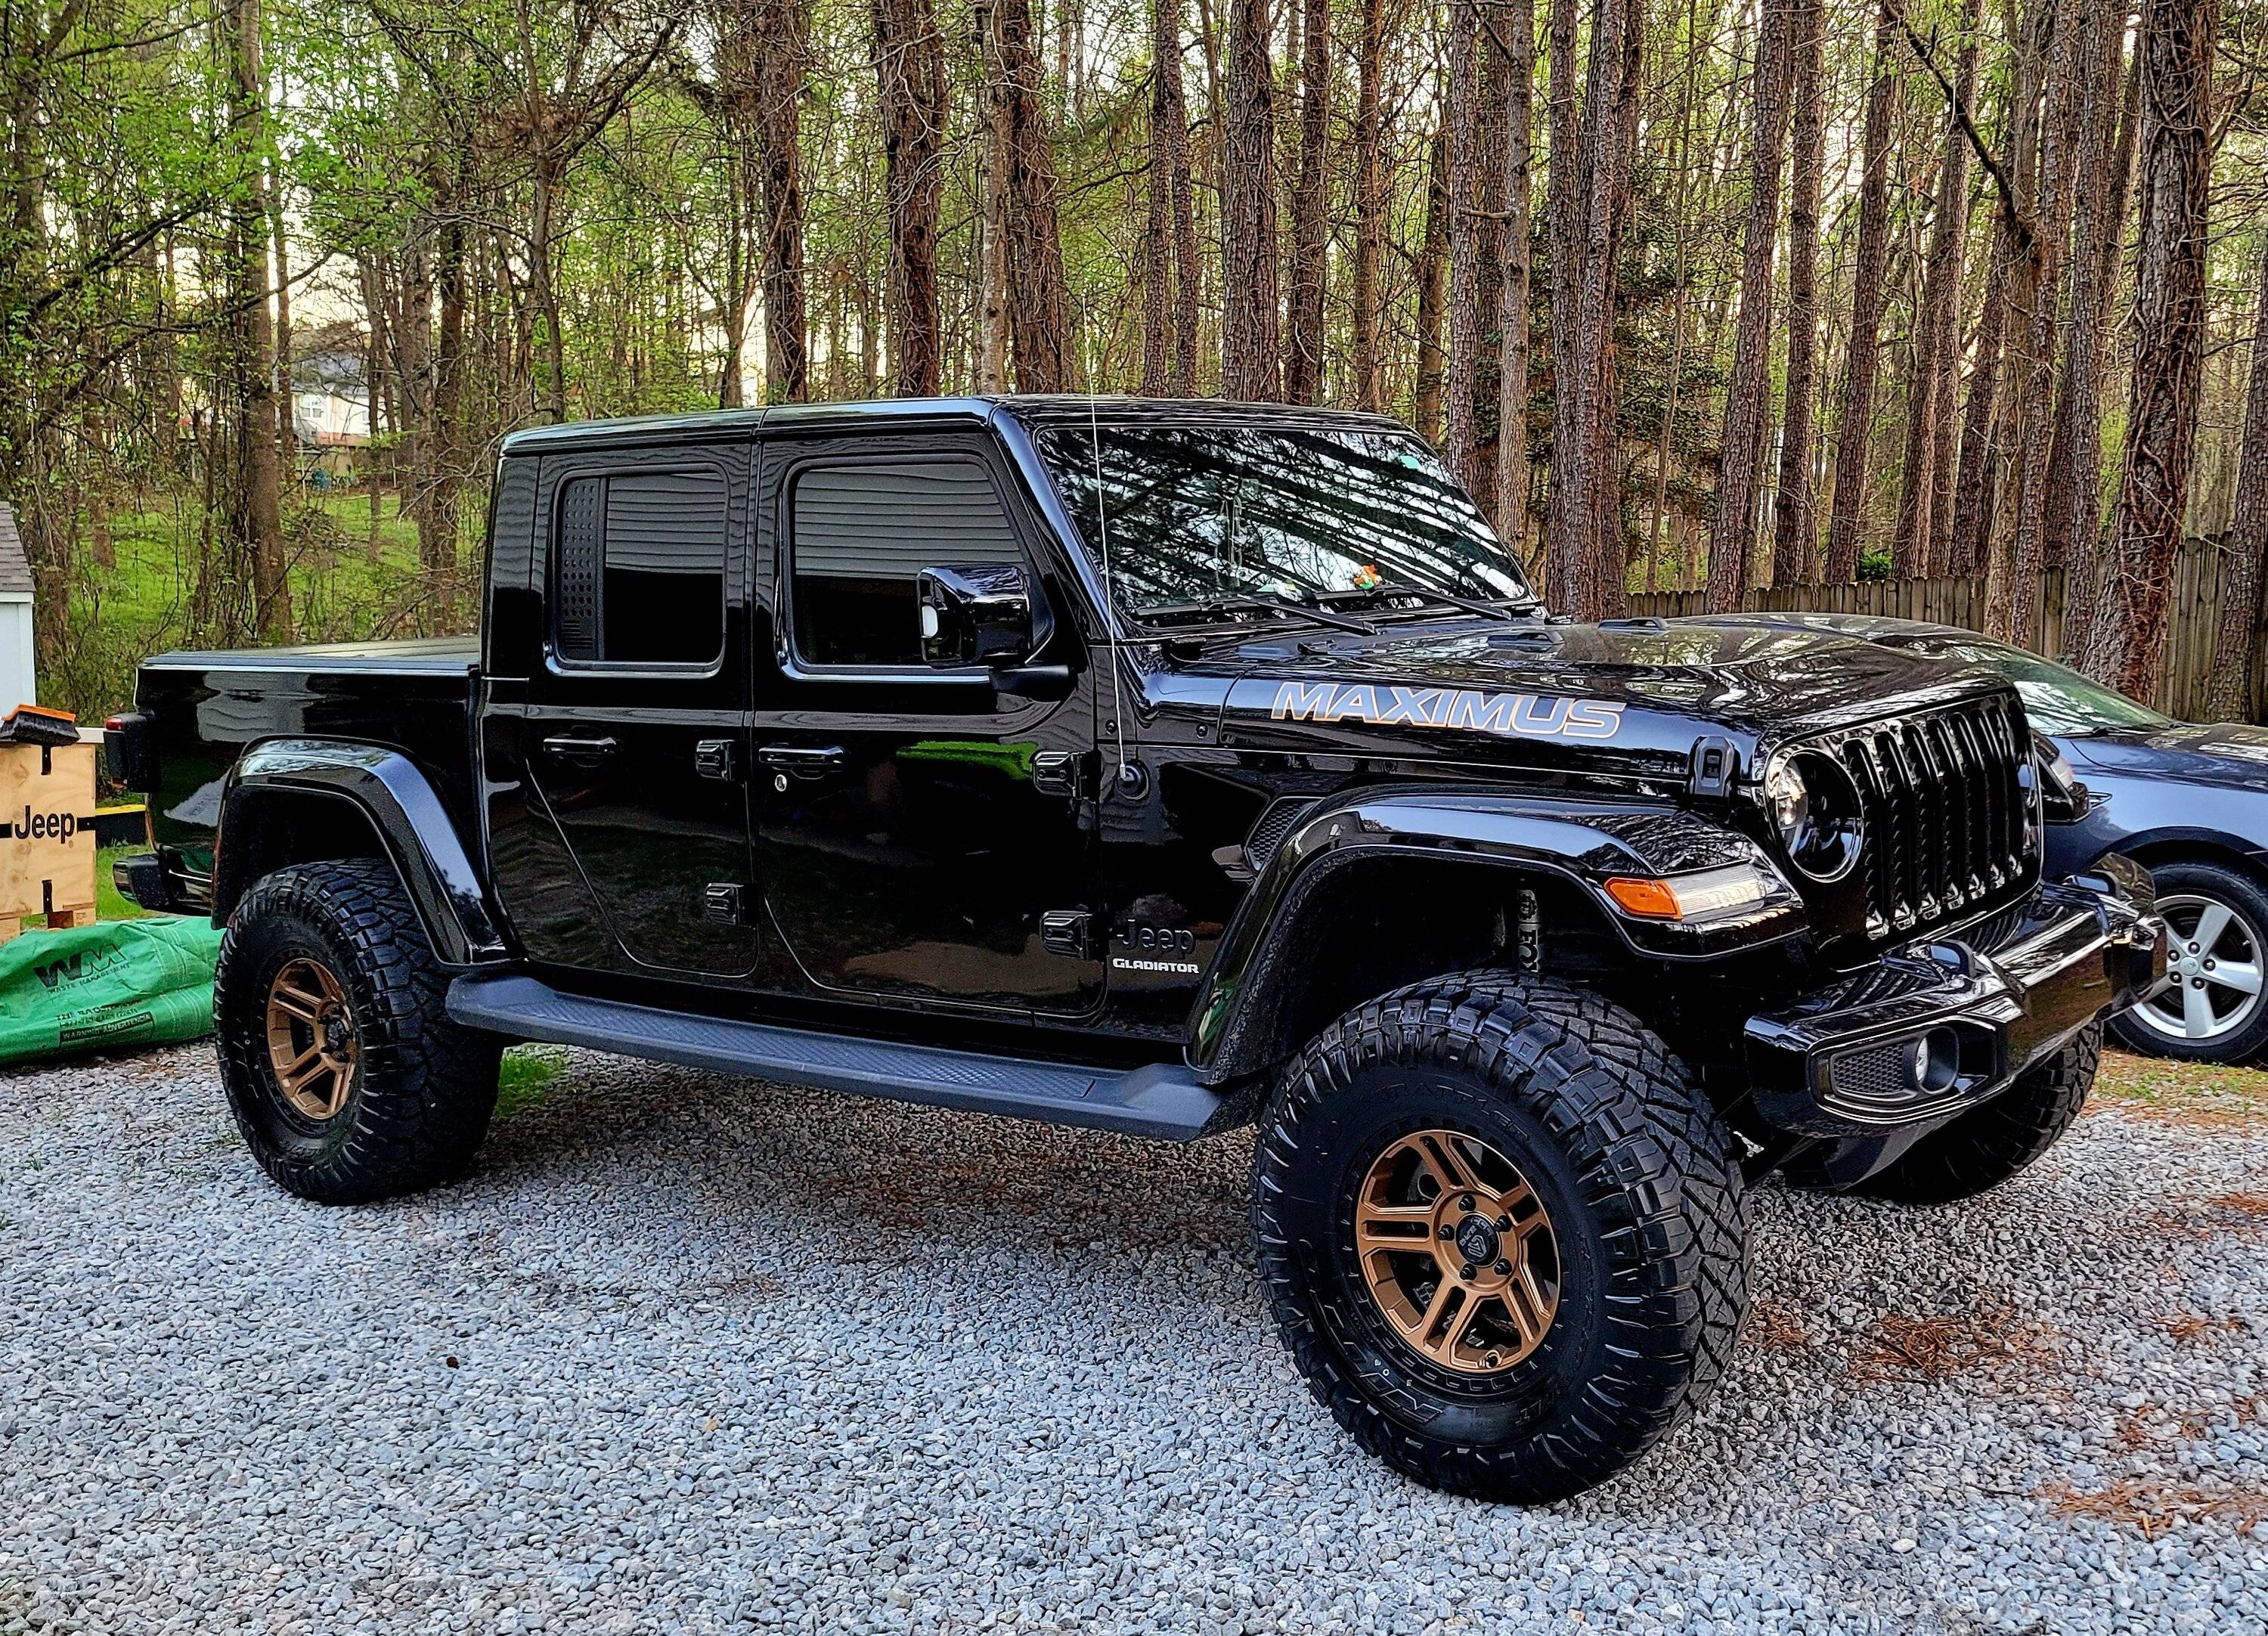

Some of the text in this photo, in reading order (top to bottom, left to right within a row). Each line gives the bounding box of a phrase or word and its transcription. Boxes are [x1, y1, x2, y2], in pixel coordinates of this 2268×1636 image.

[1271, 681, 1627, 739] MAXIMUS
[14, 804, 75, 844] Jeep
[1117, 919, 1196, 959] Jeep
[33, 943, 128, 989] WM
[48, 962, 131, 995] WASTE MANAGEMENT
